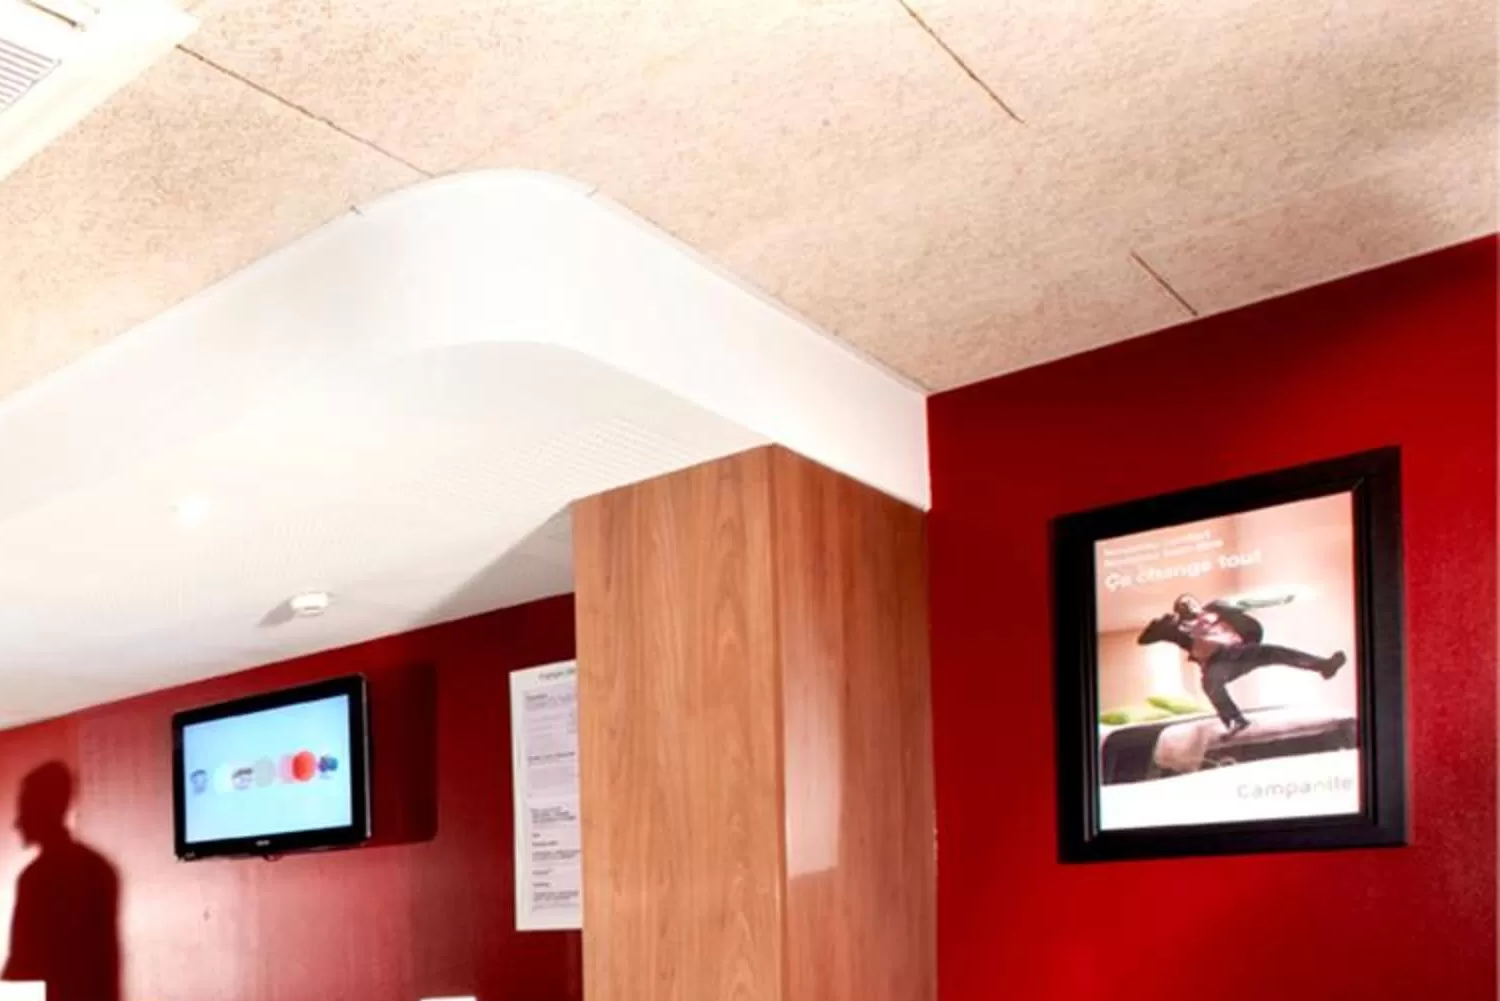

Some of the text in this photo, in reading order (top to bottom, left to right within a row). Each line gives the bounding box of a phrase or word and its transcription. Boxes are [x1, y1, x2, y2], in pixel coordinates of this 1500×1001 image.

[1136, 560, 1213, 584] change
[1218, 549, 1262, 569] tout
[1236, 776, 1353, 800] Campanile
